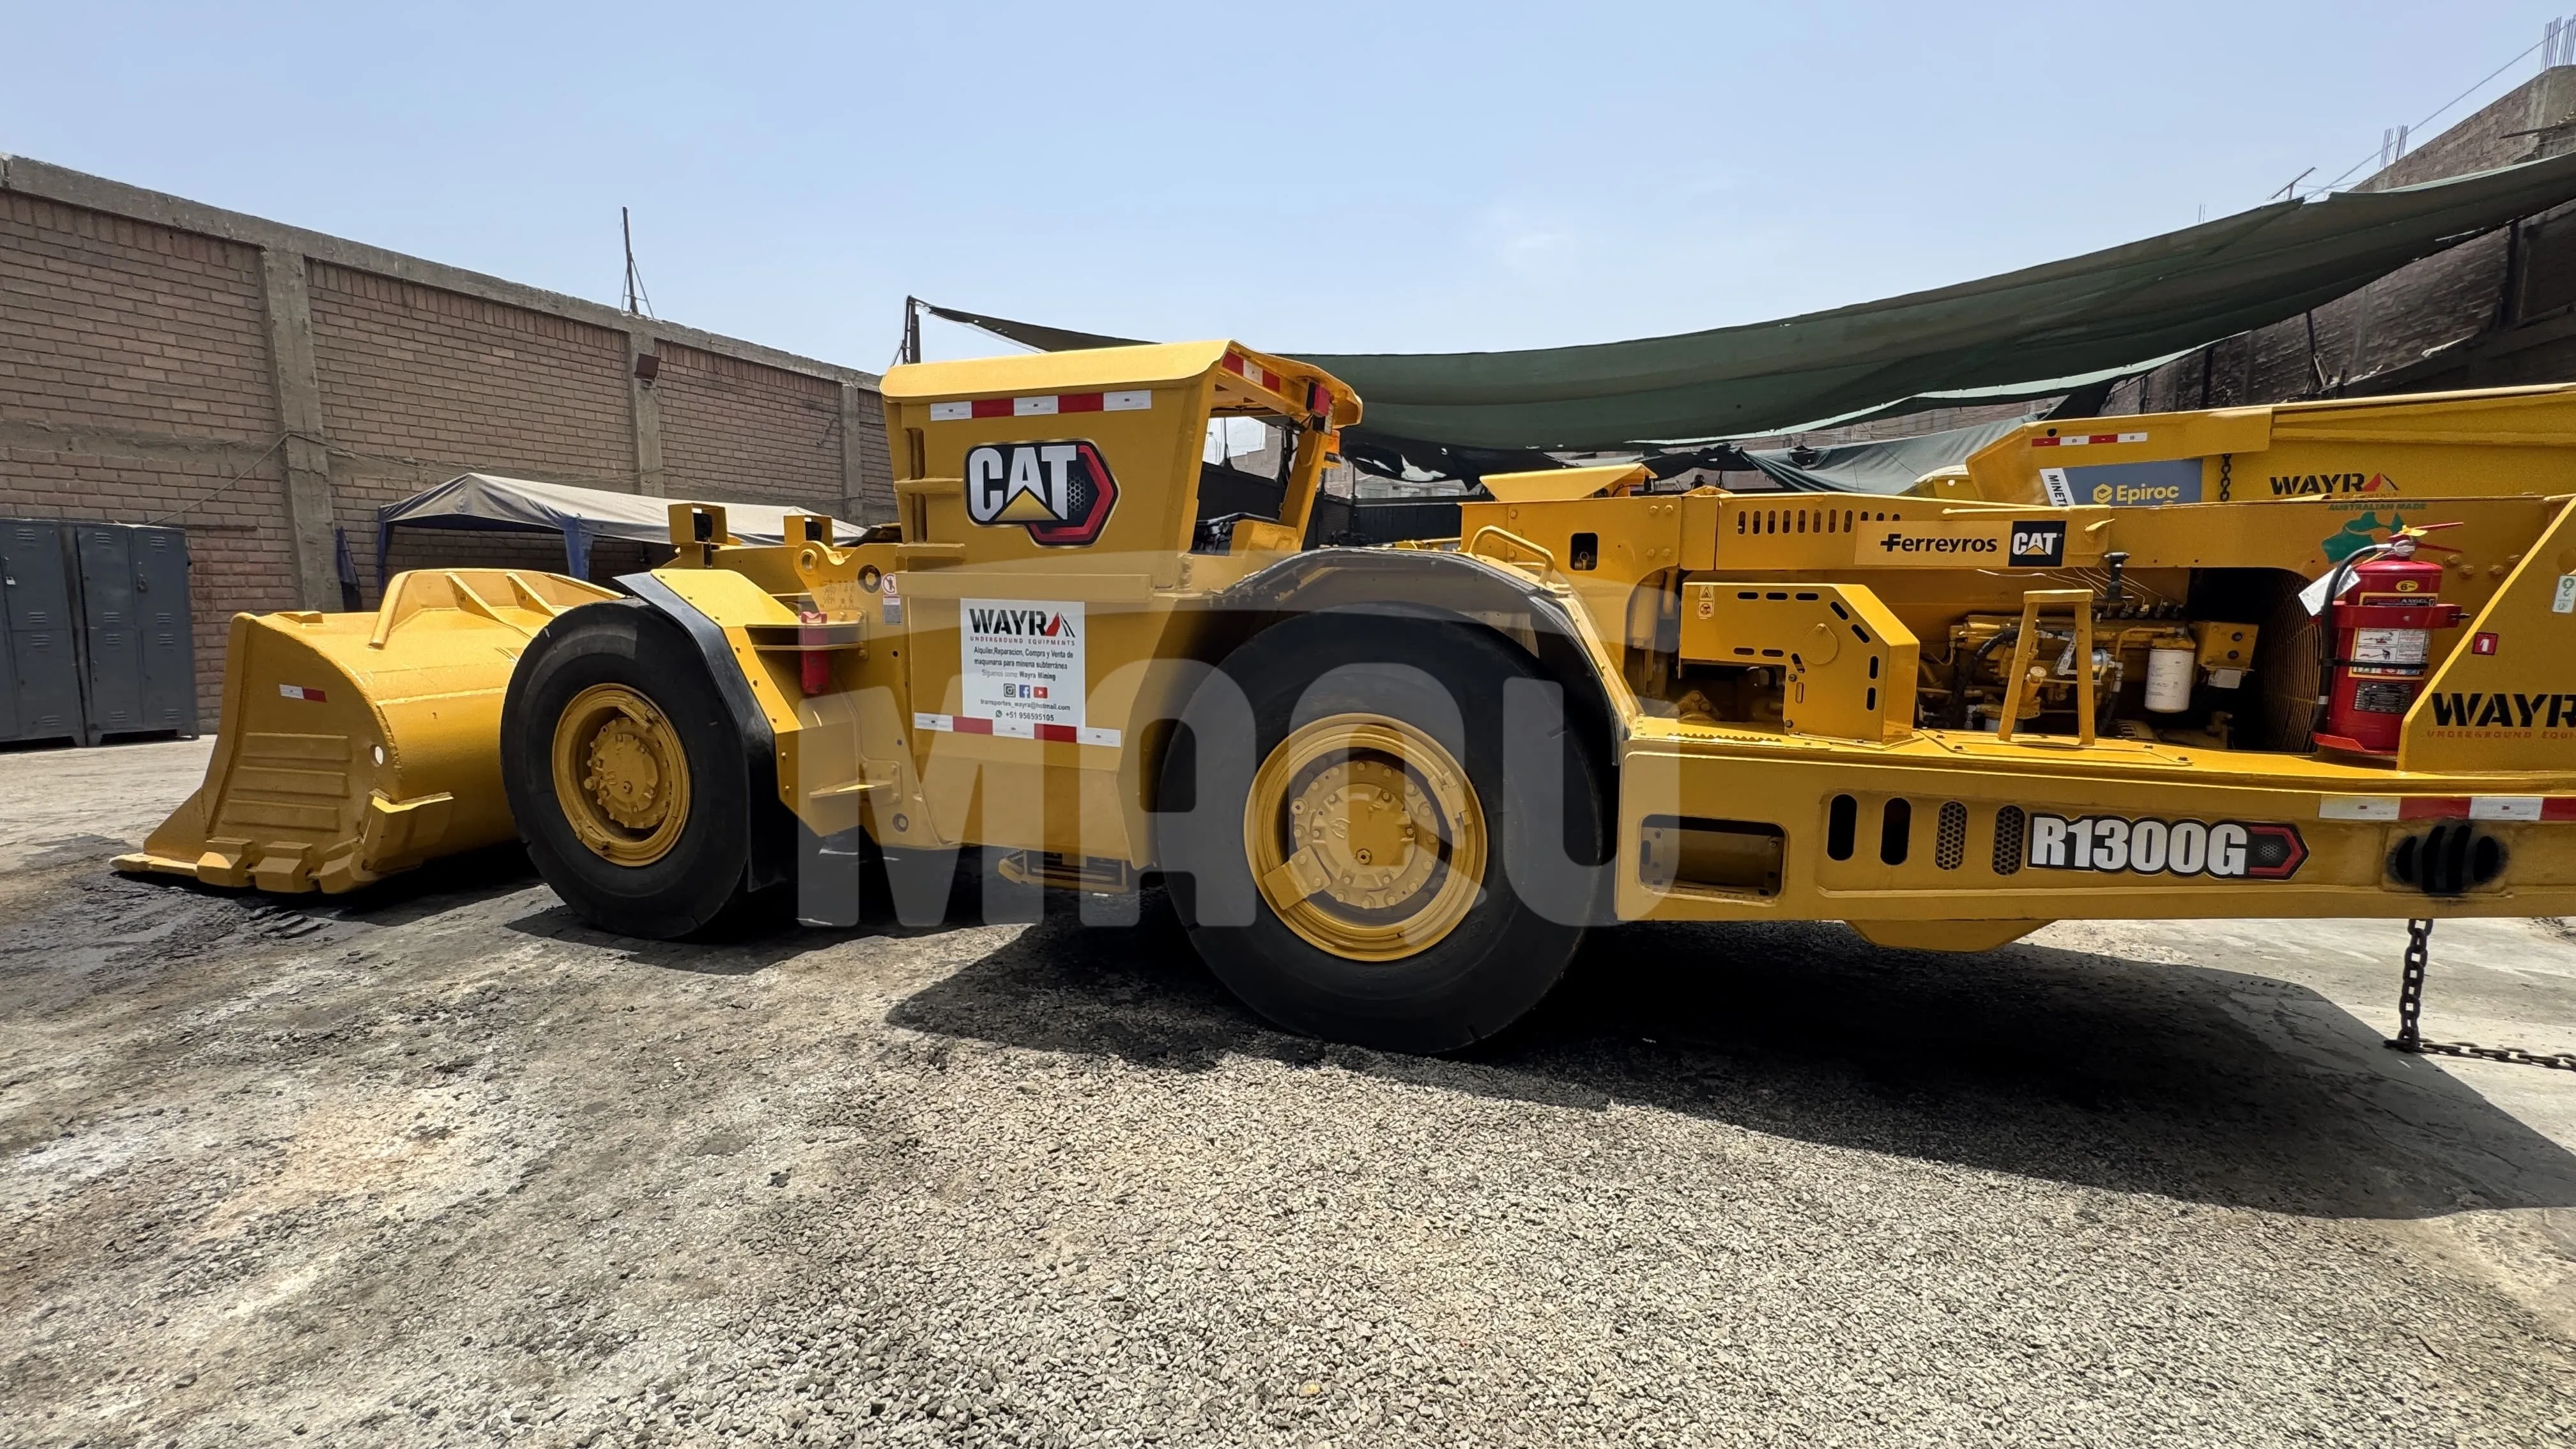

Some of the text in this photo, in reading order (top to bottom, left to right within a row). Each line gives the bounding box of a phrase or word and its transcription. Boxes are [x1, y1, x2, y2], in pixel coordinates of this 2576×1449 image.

[969, 445, 1077, 522] CAT
[2117, 483, 2180, 505] Epiroc
[1880, 532, 2058, 555] Ferreyros CAT
[970, 636, 1023, 644] UNDERGROUND
[1025, 648, 1045, 658] Compra
[1051, 650, 1066, 658] Venta
[1066, 650, 1074, 659] de
[1019, 671, 1036, 680] Wayra
[2032, 816, 2248, 875] R1300G
